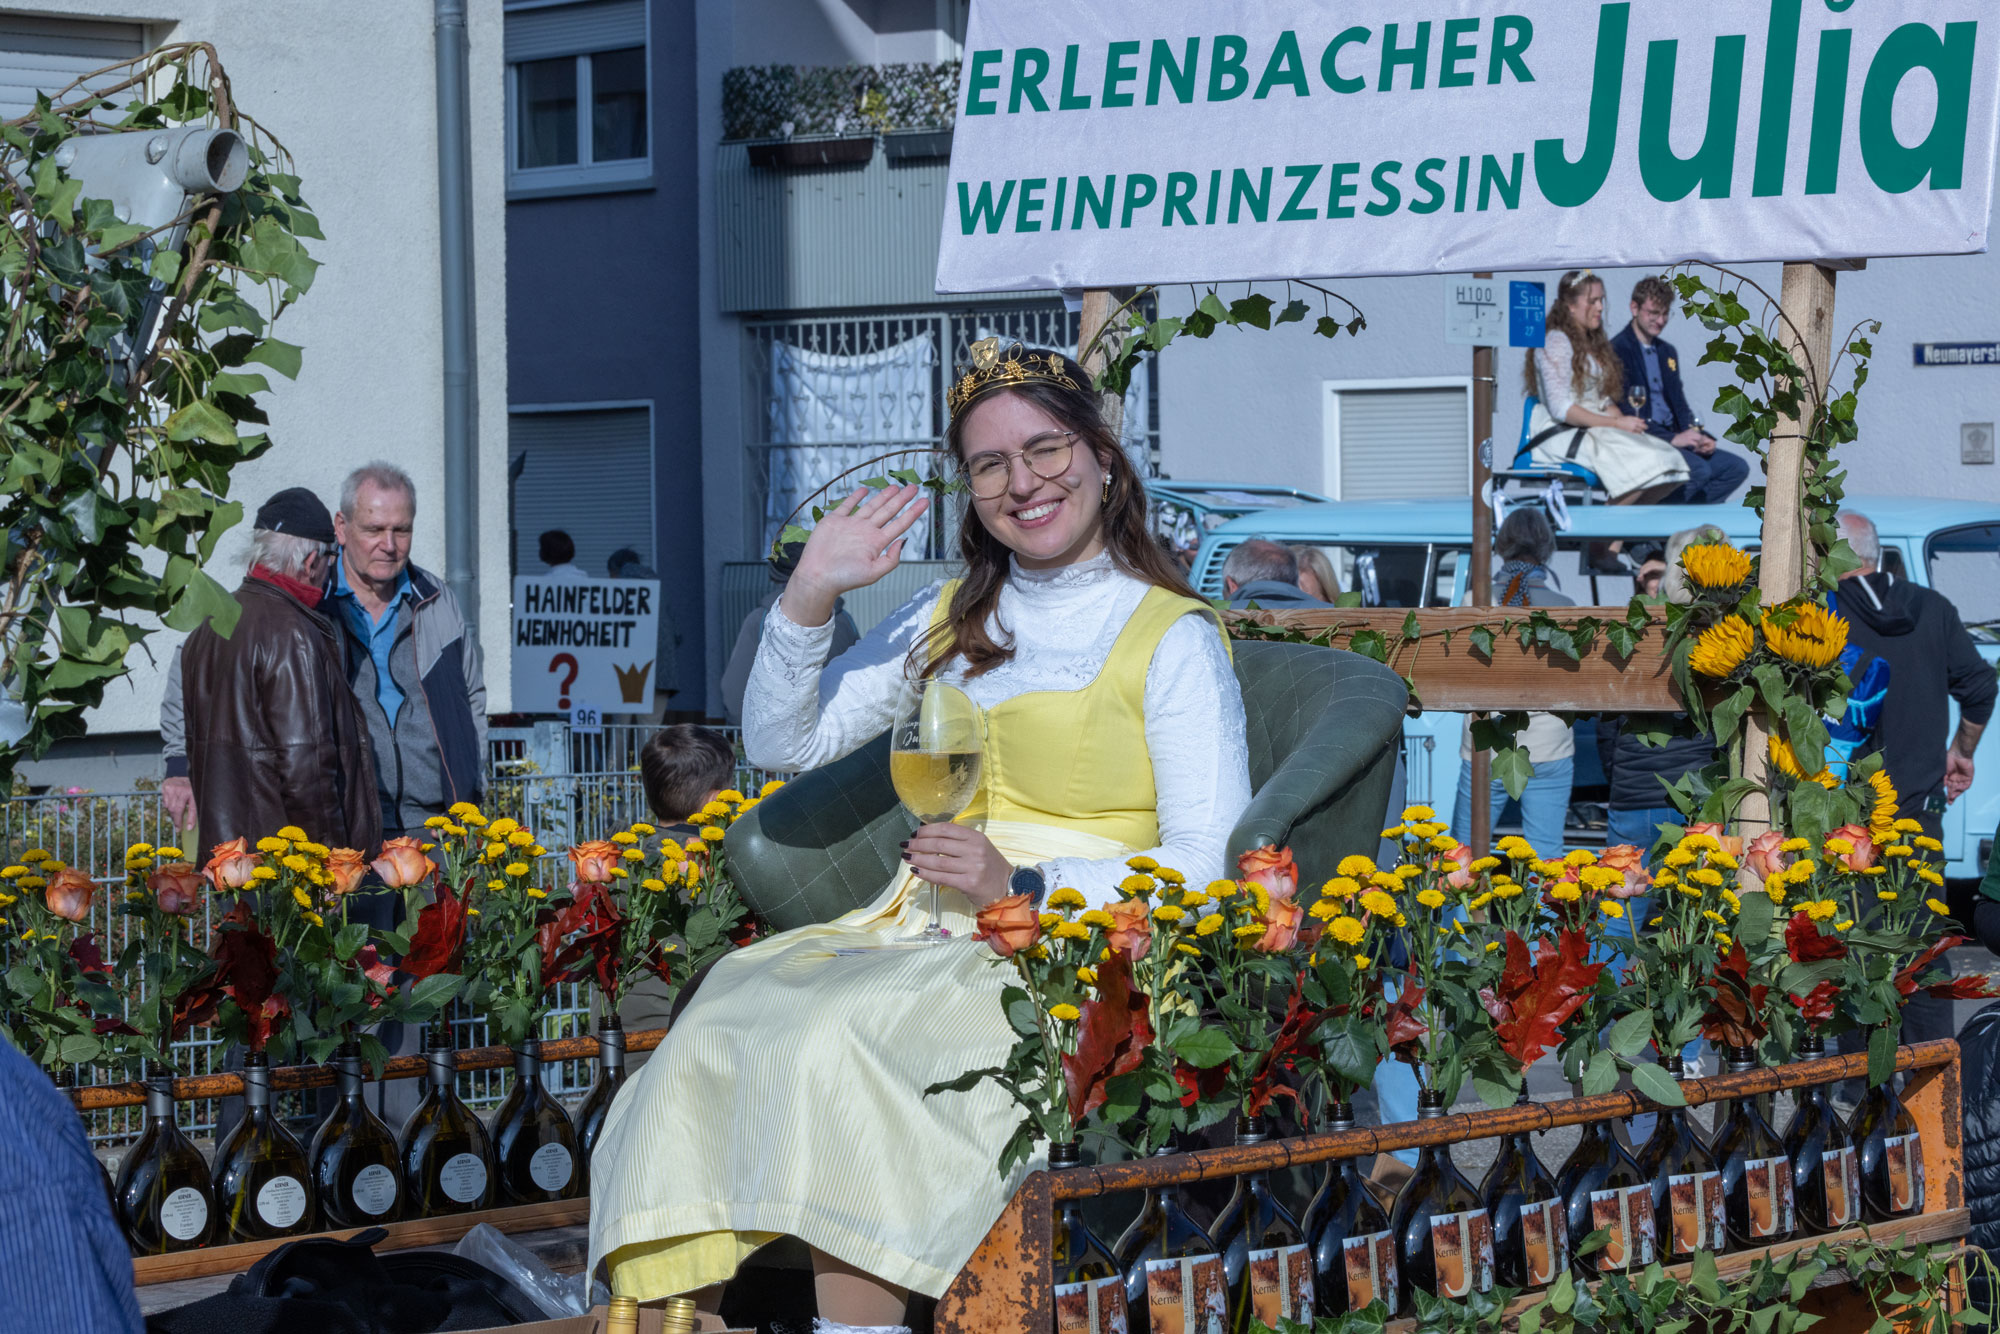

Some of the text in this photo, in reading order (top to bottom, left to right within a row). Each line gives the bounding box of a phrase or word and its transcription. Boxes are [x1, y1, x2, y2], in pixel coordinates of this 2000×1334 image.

[965, 15, 1537, 117] ERLENBACHER
[1534, 0, 1978, 208] Julia
[957, 153, 1525, 236] WEINPRINZESSIN
[1456, 286, 1492, 302] H100
[525, 584, 651, 616] HAINFELDER
[517, 619, 636, 648] WEINHOHEIT
[577, 709, 597, 725] 96
[1673, 1205, 1696, 1216] Kerner
[1525, 1235, 1547, 1247] Kerner
[1435, 1247, 1463, 1259] Kerner
[1348, 1271, 1372, 1282] Kerner
[1252, 1284, 1279, 1296] Kerner
[1150, 1294, 1183, 1307] Kerner
[1059, 1319, 1089, 1332] Kerner
